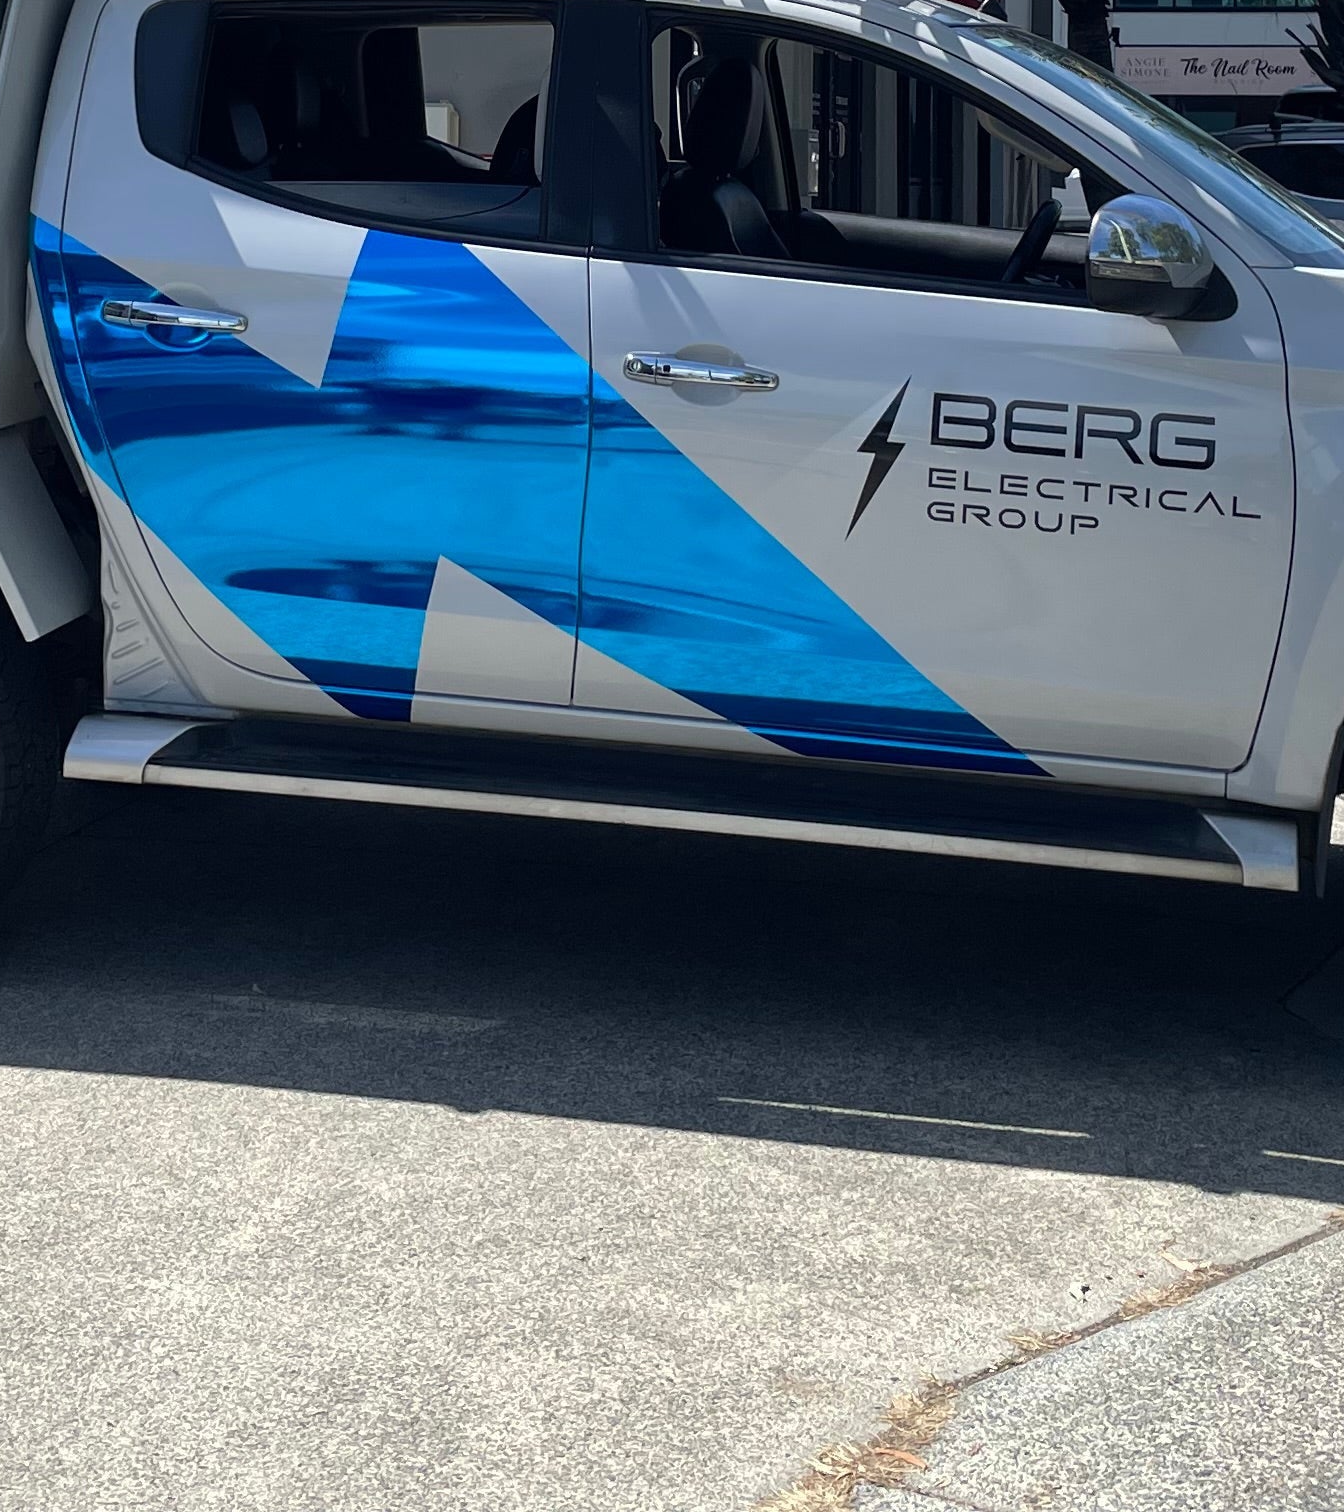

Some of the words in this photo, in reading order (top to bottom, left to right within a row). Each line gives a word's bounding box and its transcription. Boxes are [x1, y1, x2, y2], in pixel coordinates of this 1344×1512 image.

[1180, 58, 1207, 76] The
[1211, 58, 1250, 77] Nail
[1252, 58, 1298, 80] Room
[930, 392, 1216, 470] BERG
[928, 467, 1262, 519] ELECTRICAL
[927, 501, 1099, 535] GROUP
